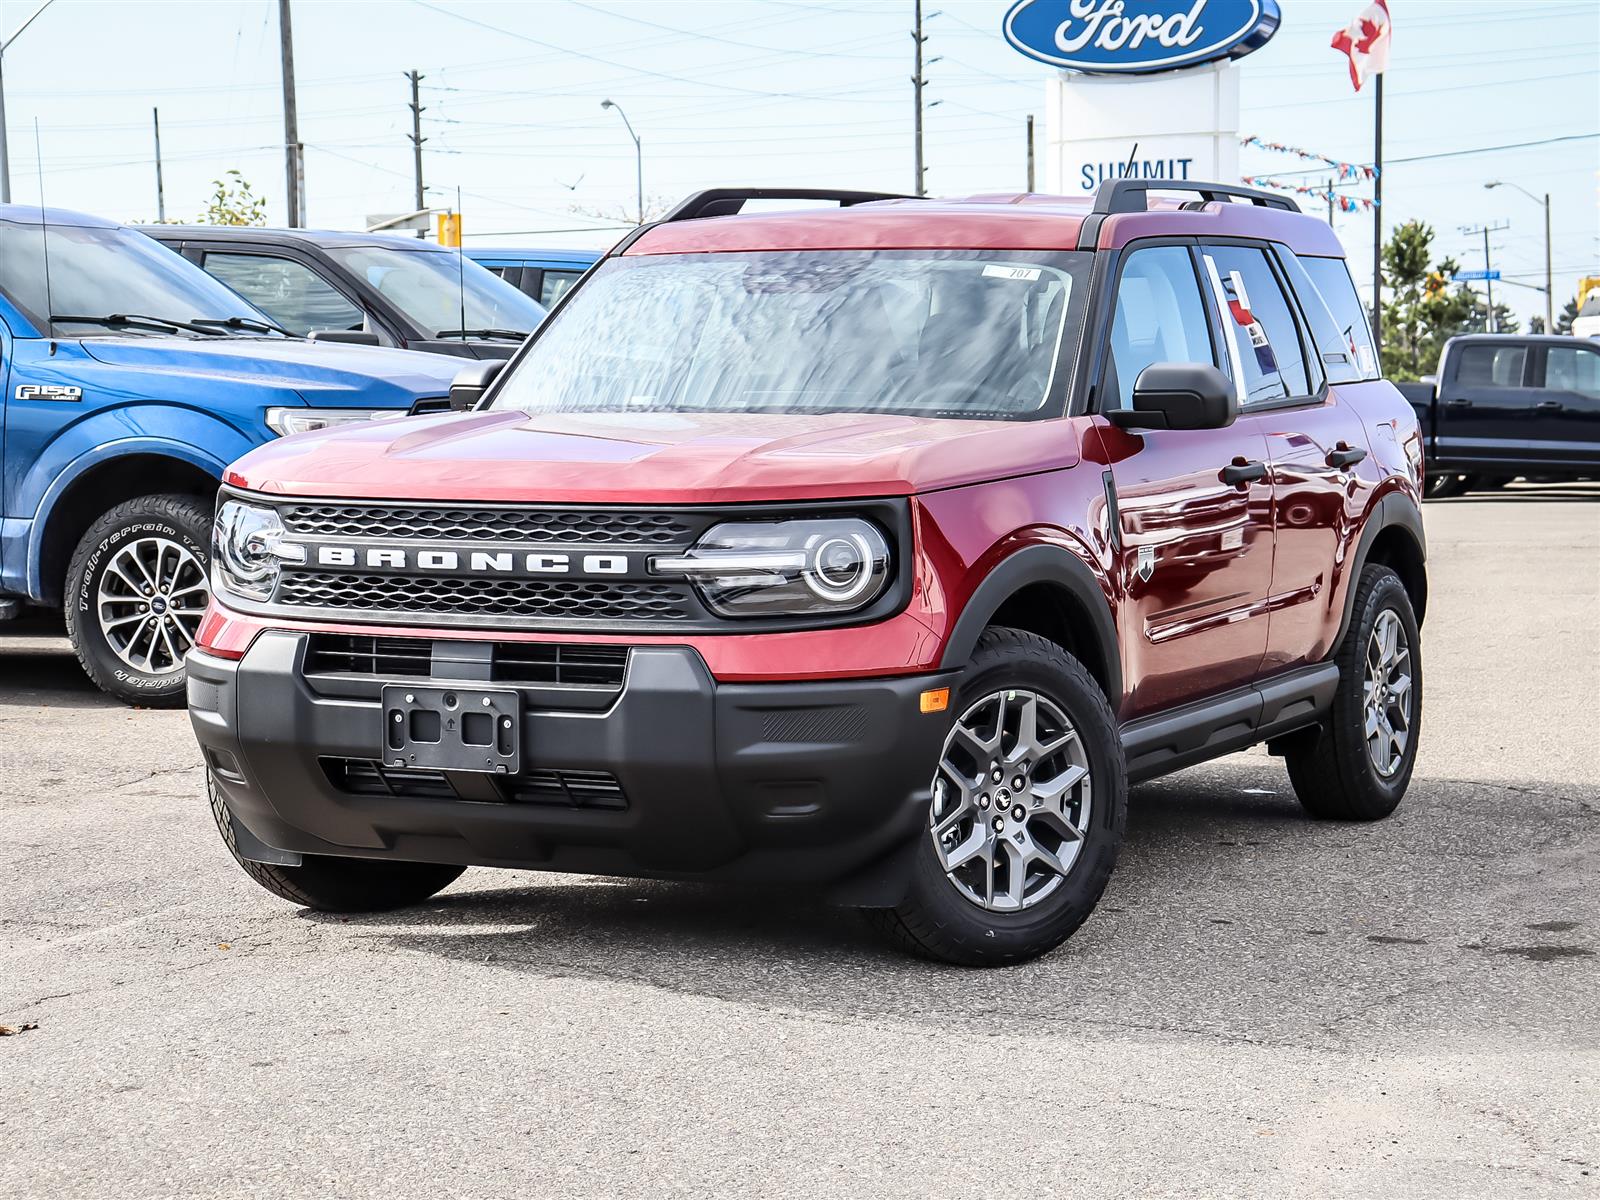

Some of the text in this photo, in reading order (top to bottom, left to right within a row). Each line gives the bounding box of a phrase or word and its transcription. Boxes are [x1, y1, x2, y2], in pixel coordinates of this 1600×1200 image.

[1055, 0, 1207, 52] Ford
[1081, 158, 1193, 190] SUMMIT
[1010, 268, 1032, 279] 707
[318, 545, 629, 575] BRONCO
[113, 669, 185, 689] odrich
